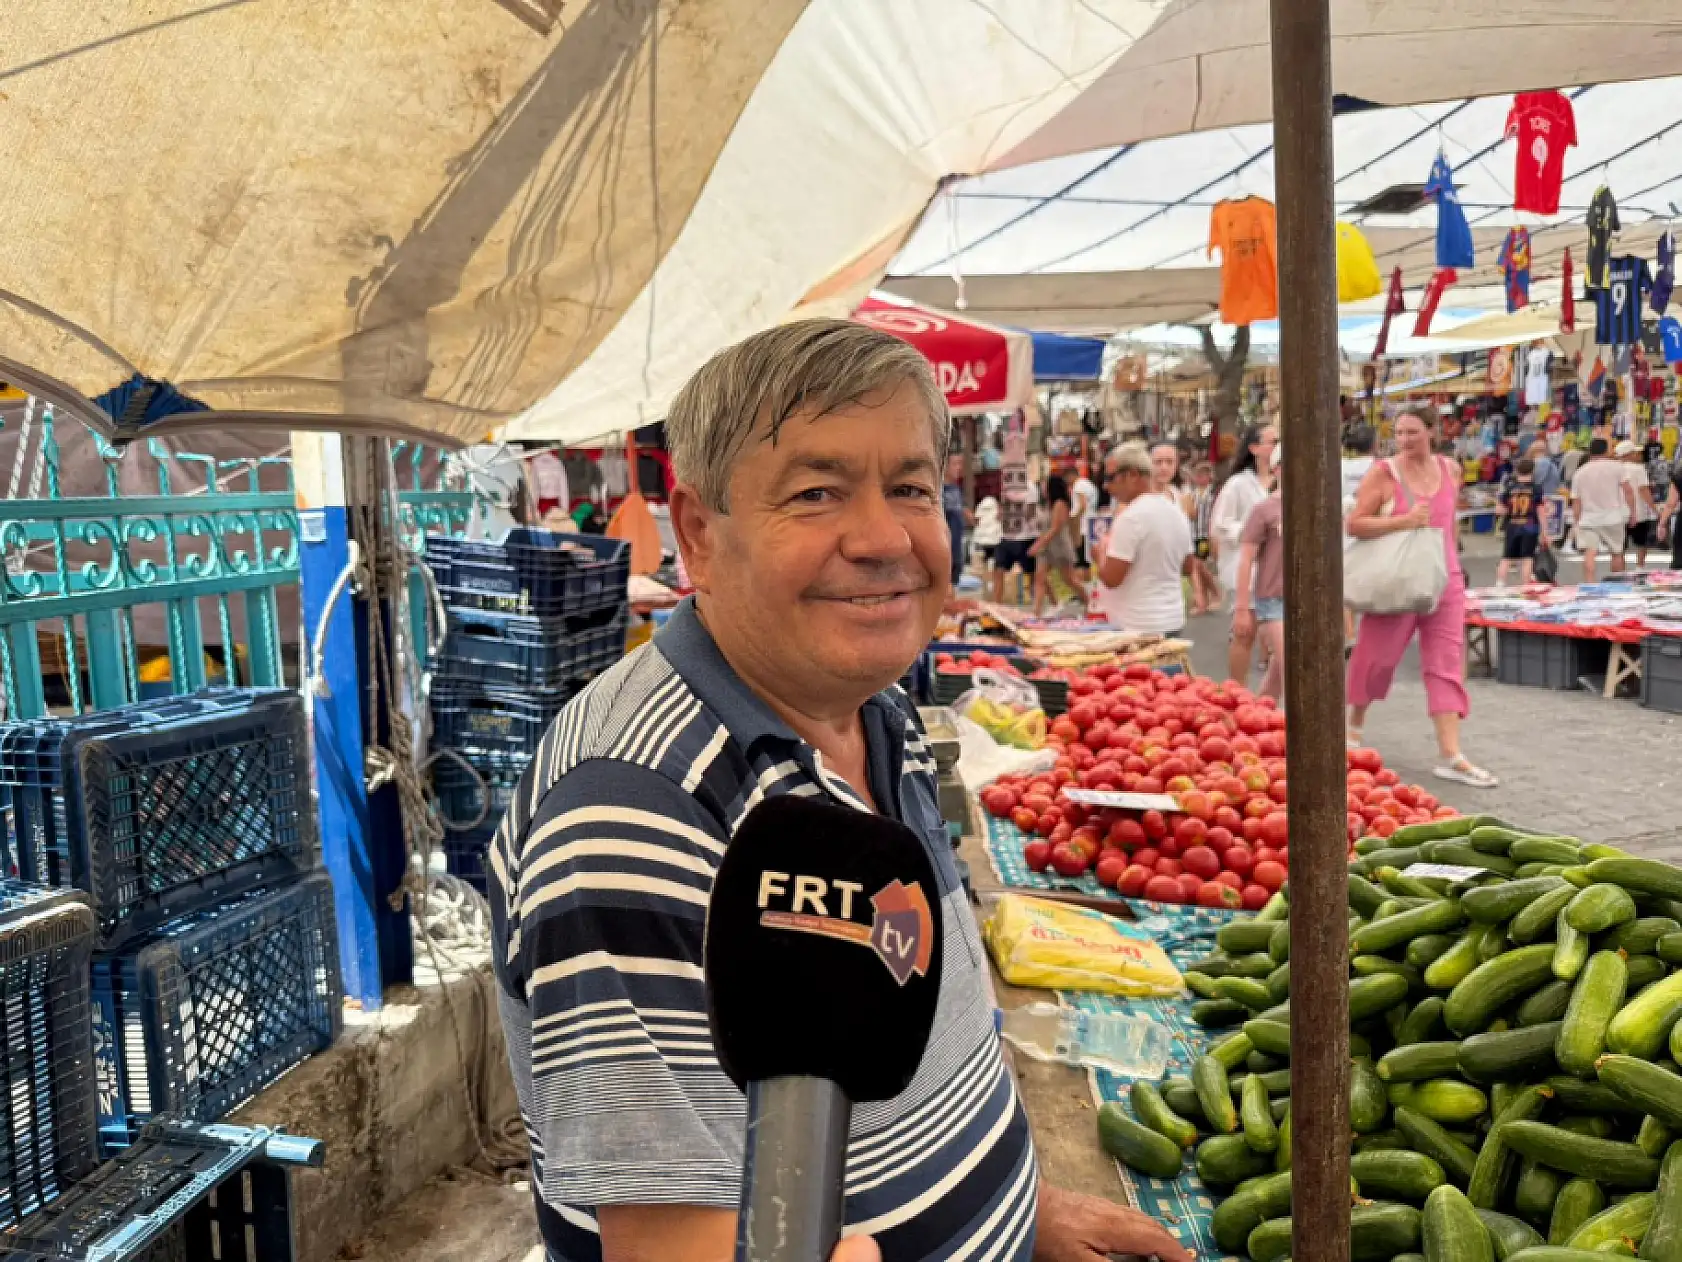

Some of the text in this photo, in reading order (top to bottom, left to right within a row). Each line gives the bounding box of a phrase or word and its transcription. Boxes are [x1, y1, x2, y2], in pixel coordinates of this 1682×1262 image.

[1612, 282, 1627, 316] 9
[757, 869, 864, 919] FRT
[880, 919, 915, 959] tv
